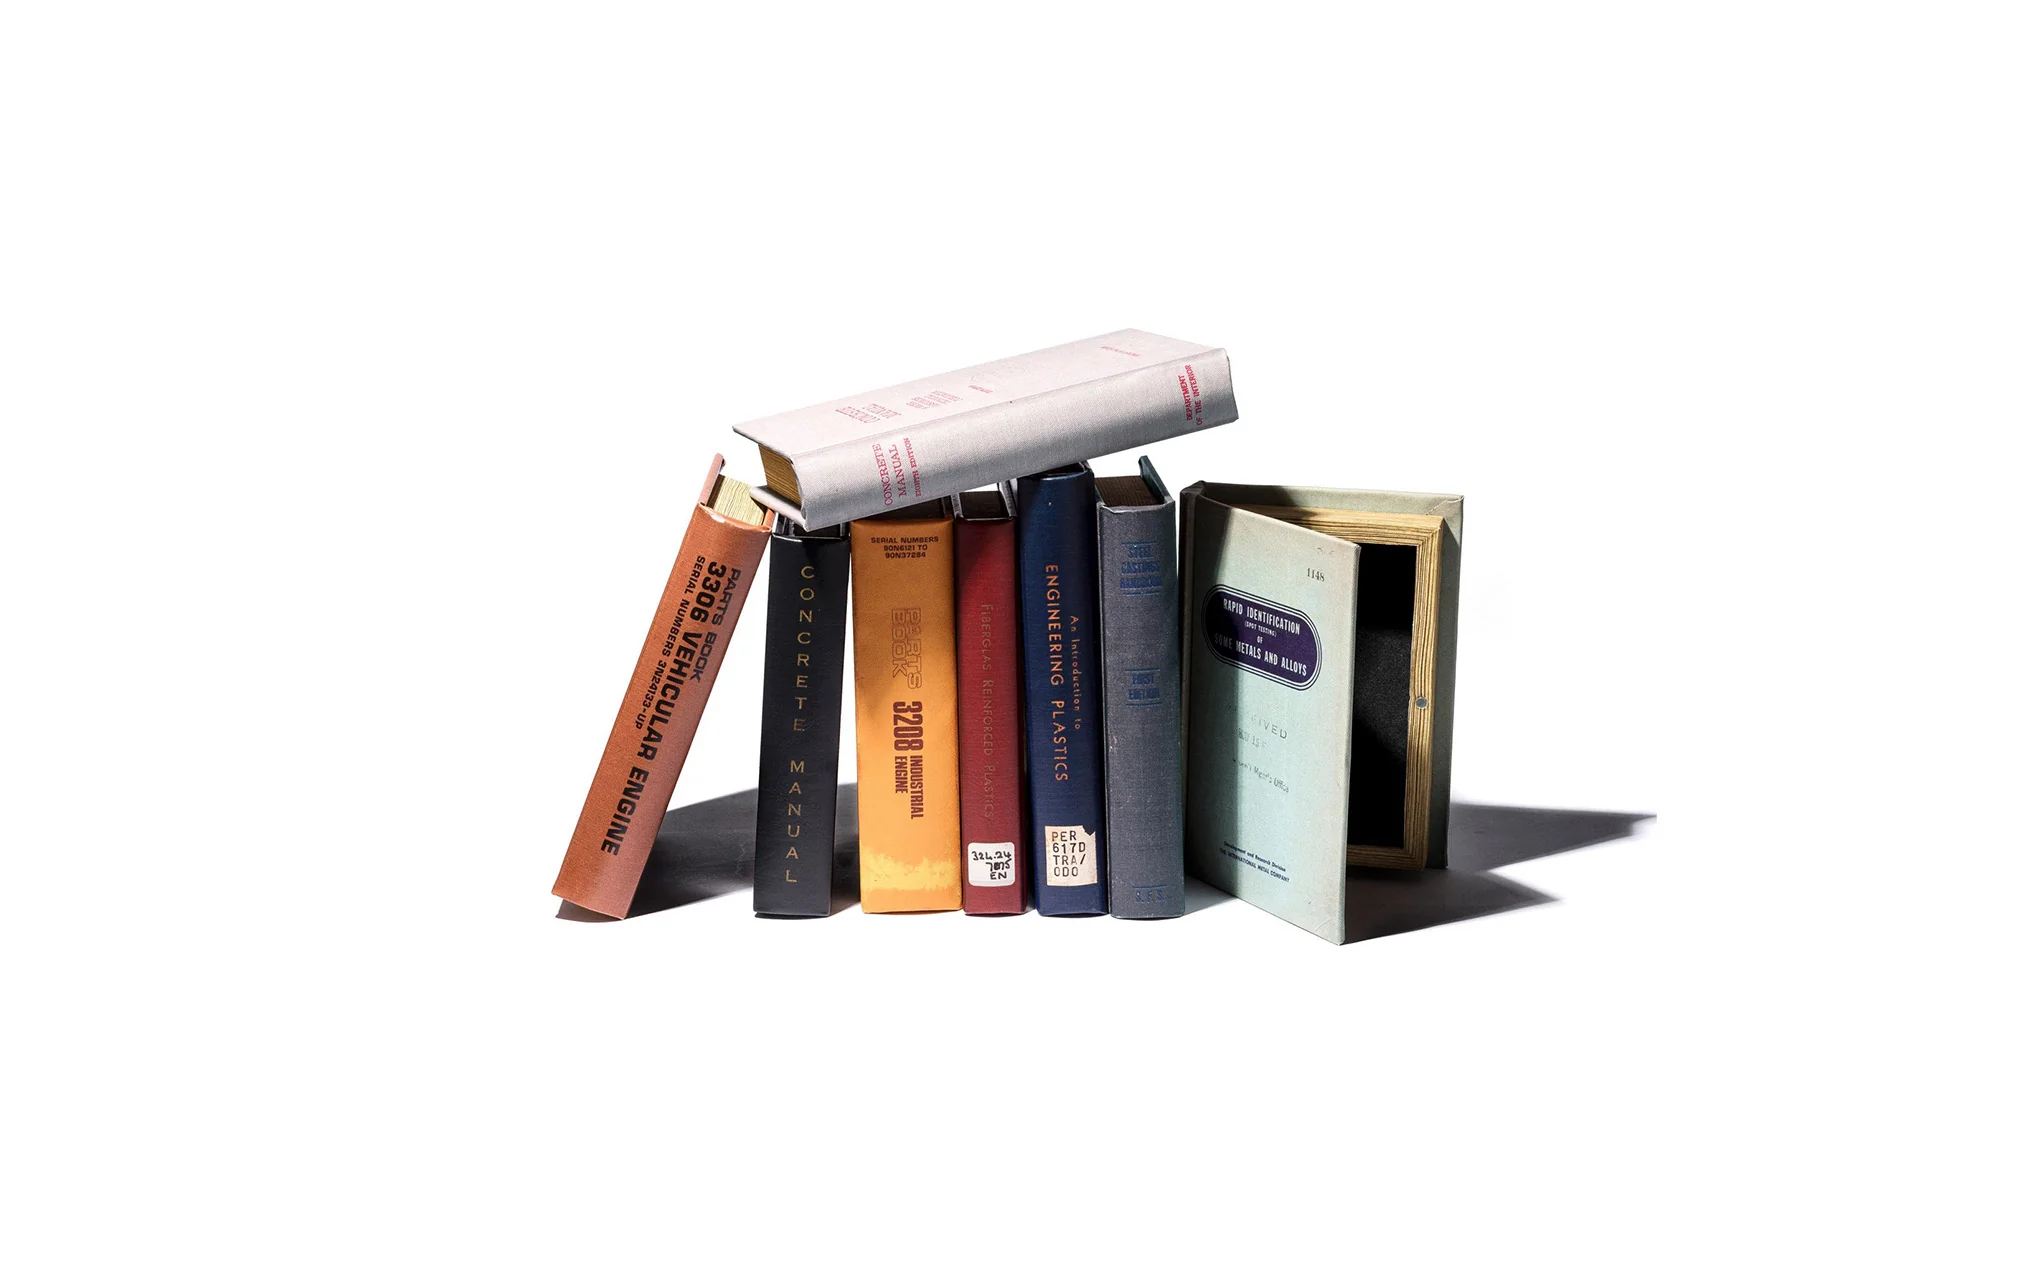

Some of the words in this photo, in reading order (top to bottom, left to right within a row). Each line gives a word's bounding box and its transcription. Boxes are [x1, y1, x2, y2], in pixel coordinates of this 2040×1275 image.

[1178, 374, 1193, 421] DEPARTMENT
[1185, 365, 1200, 398] INTERIOR
[1195, 400, 1203, 415] THE
[872, 443, 894, 506] CONCRETE
[889, 444, 907, 498] MANUAL
[903, 438, 917, 468] EDITION
[870, 536, 898, 544] SERIAL
[900, 535, 939, 544] NUMBERS
[684, 555, 706, 595] SERIAL
[690, 561, 727, 623] 3306
[711, 567, 742, 626] PARTS
[1307, 568, 1325, 582] 1148
[661, 598, 690, 658] NUMBERS
[1045, 564, 1064, 686] ENGINEERING
[1069, 615, 1079, 632] An
[1223, 598, 1243, 615] RAPID
[1246, 606, 1301, 635] IDENTIFICATION
[1256, 635, 1263, 644] OF
[689, 631, 718, 683] BOOK
[792, 565, 815, 732] CONCRETE
[1214, 632, 1233, 649] SOME
[1235, 640, 1262, 660] METALS
[1264, 650, 1278, 666] AND
[1281, 657, 1308, 677] ALLOYS
[635, 660, 667, 730] 3N24133-UP
[636, 631, 703, 761] VEHICULAR
[1071, 638, 1082, 711] Introduction
[892, 701, 924, 752] 3208
[982, 679, 994, 756] REINFORCED
[1051, 699, 1069, 781] PLASTICS
[1074, 718, 1081, 729] to
[894, 755, 908, 794] ENGINE
[910, 755, 924, 820] INDUSTRIAL
[984, 764, 996, 818] PLASTICS
[600, 765, 650, 856] ENGINE
[785, 759, 805, 883] MANUAL
[971, 850, 1012, 861] 324.24
[1051, 830, 1077, 842] PER
[1052, 841, 1086, 854] 617D
[1052, 853, 1086, 866] TRA/
[990, 871, 1007, 880] EN
